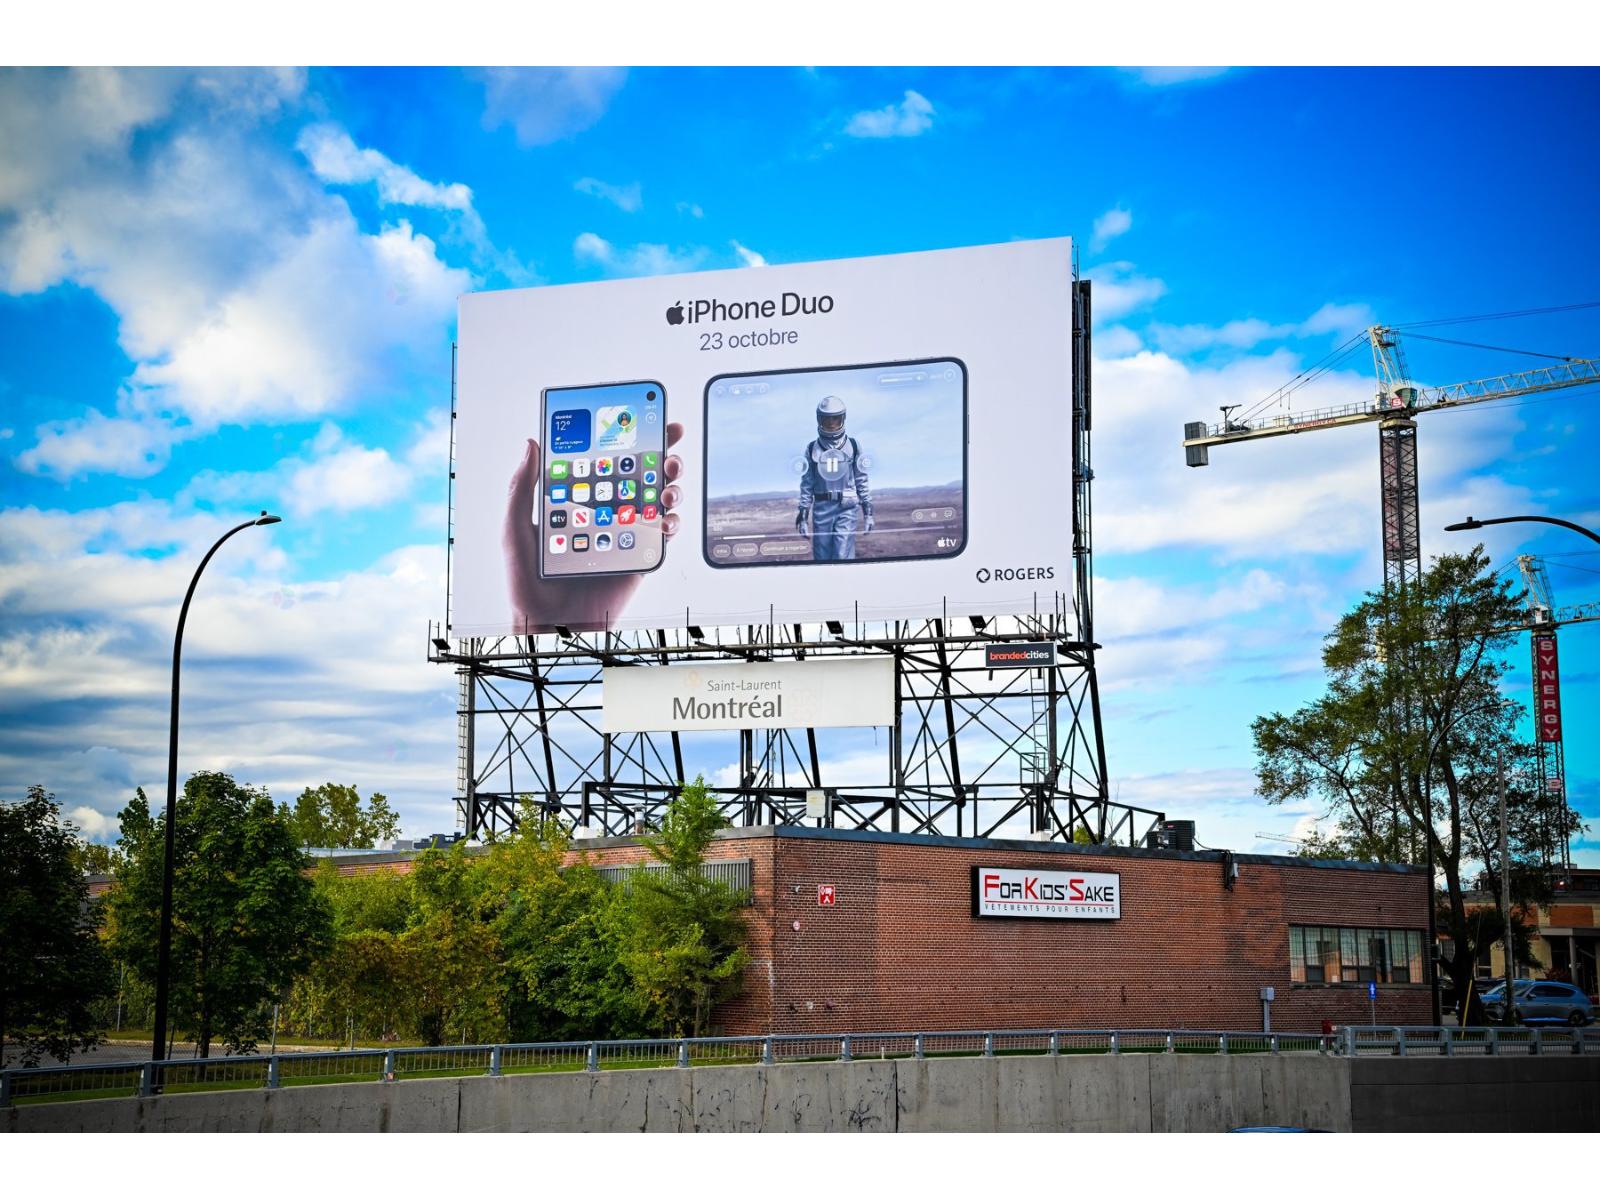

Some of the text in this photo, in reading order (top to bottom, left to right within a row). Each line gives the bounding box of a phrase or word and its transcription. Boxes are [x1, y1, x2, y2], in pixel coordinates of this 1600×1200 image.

[688, 292, 834, 324] iPhone Duo
[699, 328, 799, 351] 23 octobre
[945, 537, 957, 548] tv
[994, 566, 1055, 581] ROGERS
[989, 651, 1050, 661] brandedcities
[707, 679, 783, 692] Saint-Laurent
[1540, 640, 1559, 738] SYNERGY
[672, 694, 782, 720] Montréal
[1075, 906, 1116, 914] ENFANTS
